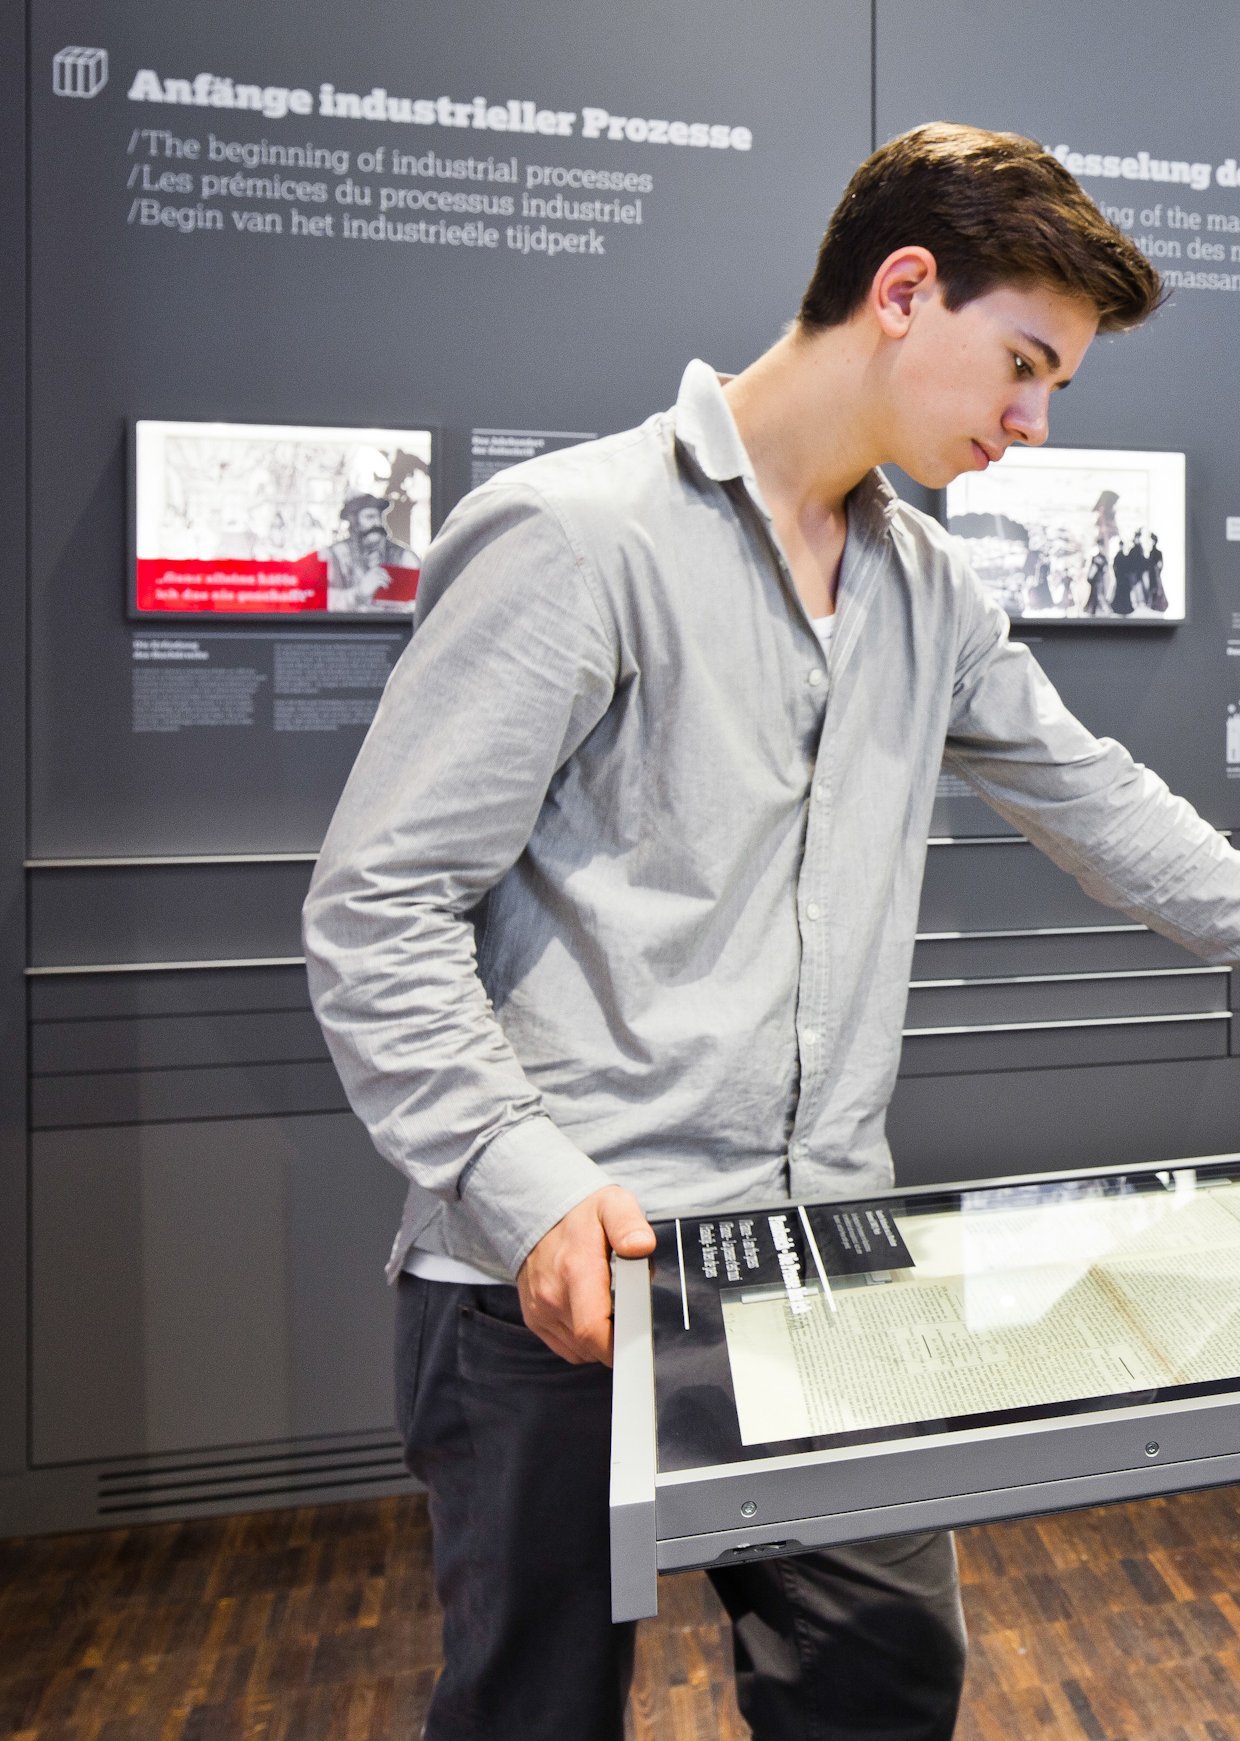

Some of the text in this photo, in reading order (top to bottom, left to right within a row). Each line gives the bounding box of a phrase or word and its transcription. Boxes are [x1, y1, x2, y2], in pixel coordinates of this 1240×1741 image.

[128, 69, 753, 151] Anfänge industrieller Prozesse
[208, 133, 349, 174] beginning
[357, 144, 385, 173] of
[392, 147, 519, 184] industrial
[526, 164, 654, 194] processes
[1043, 144, 1212, 190] fesselung
[201, 169, 328, 204] prémices
[335, 178, 371, 206] du
[380, 186, 515, 219] processus
[521, 190, 644, 225] industriel
[1099, 201, 1135, 229] ing
[1140, 204, 1163, 228] of
[1167, 205, 1201, 231] the
[232, 212, 283, 234] van
[291, 207, 335, 237] het
[505, 220, 606, 256] tijdperk
[1133, 234, 1182, 258] tion
[1187, 236, 1226, 260] des
